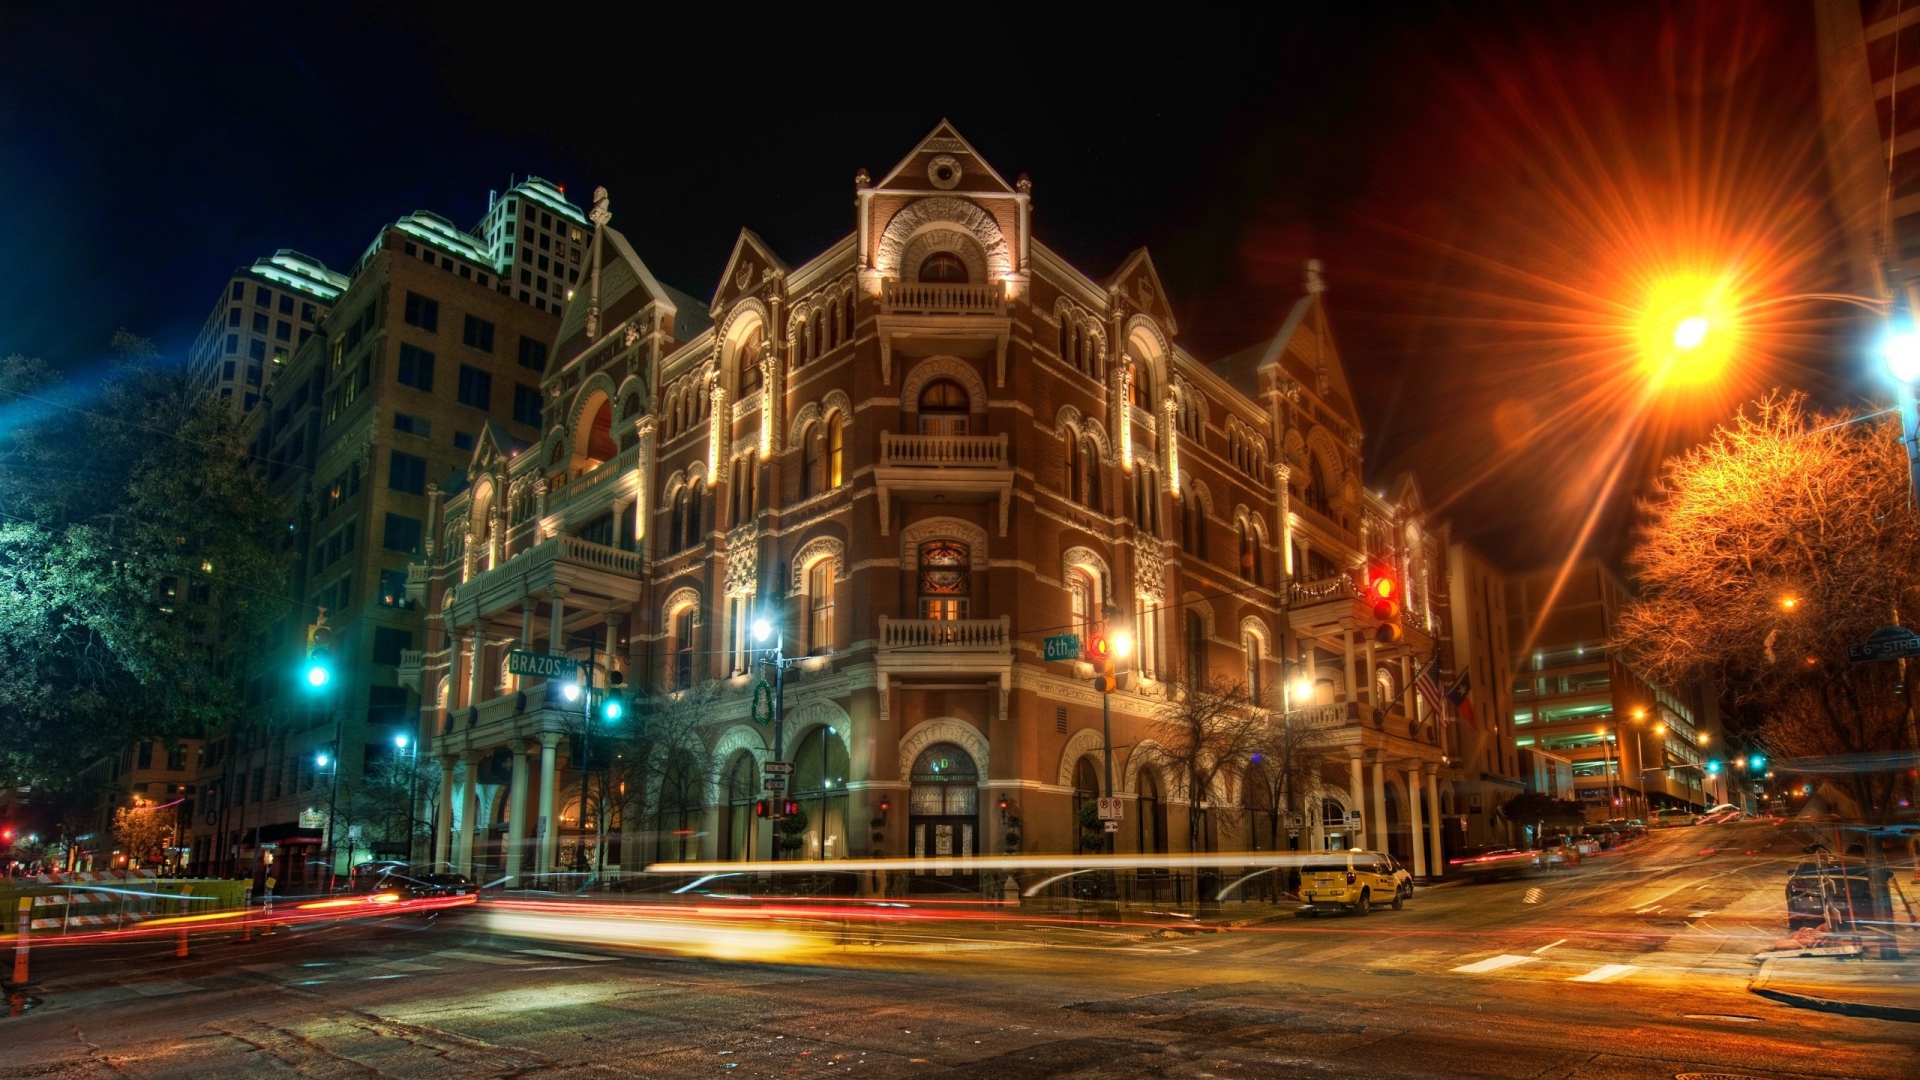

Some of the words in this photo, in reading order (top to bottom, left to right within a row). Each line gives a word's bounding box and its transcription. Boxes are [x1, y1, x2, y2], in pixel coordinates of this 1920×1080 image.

[1070, 634, 1079, 644] ST
[1047, 639, 1068, 657] 6th
[1067, 648, 1079, 658] 100
[1850, 646, 1861, 657] E
[511, 653, 561, 676] BRAZOS
[566, 658, 575, 667] ST
[561, 670, 576, 680] 600
[941, 758, 948, 768] D
